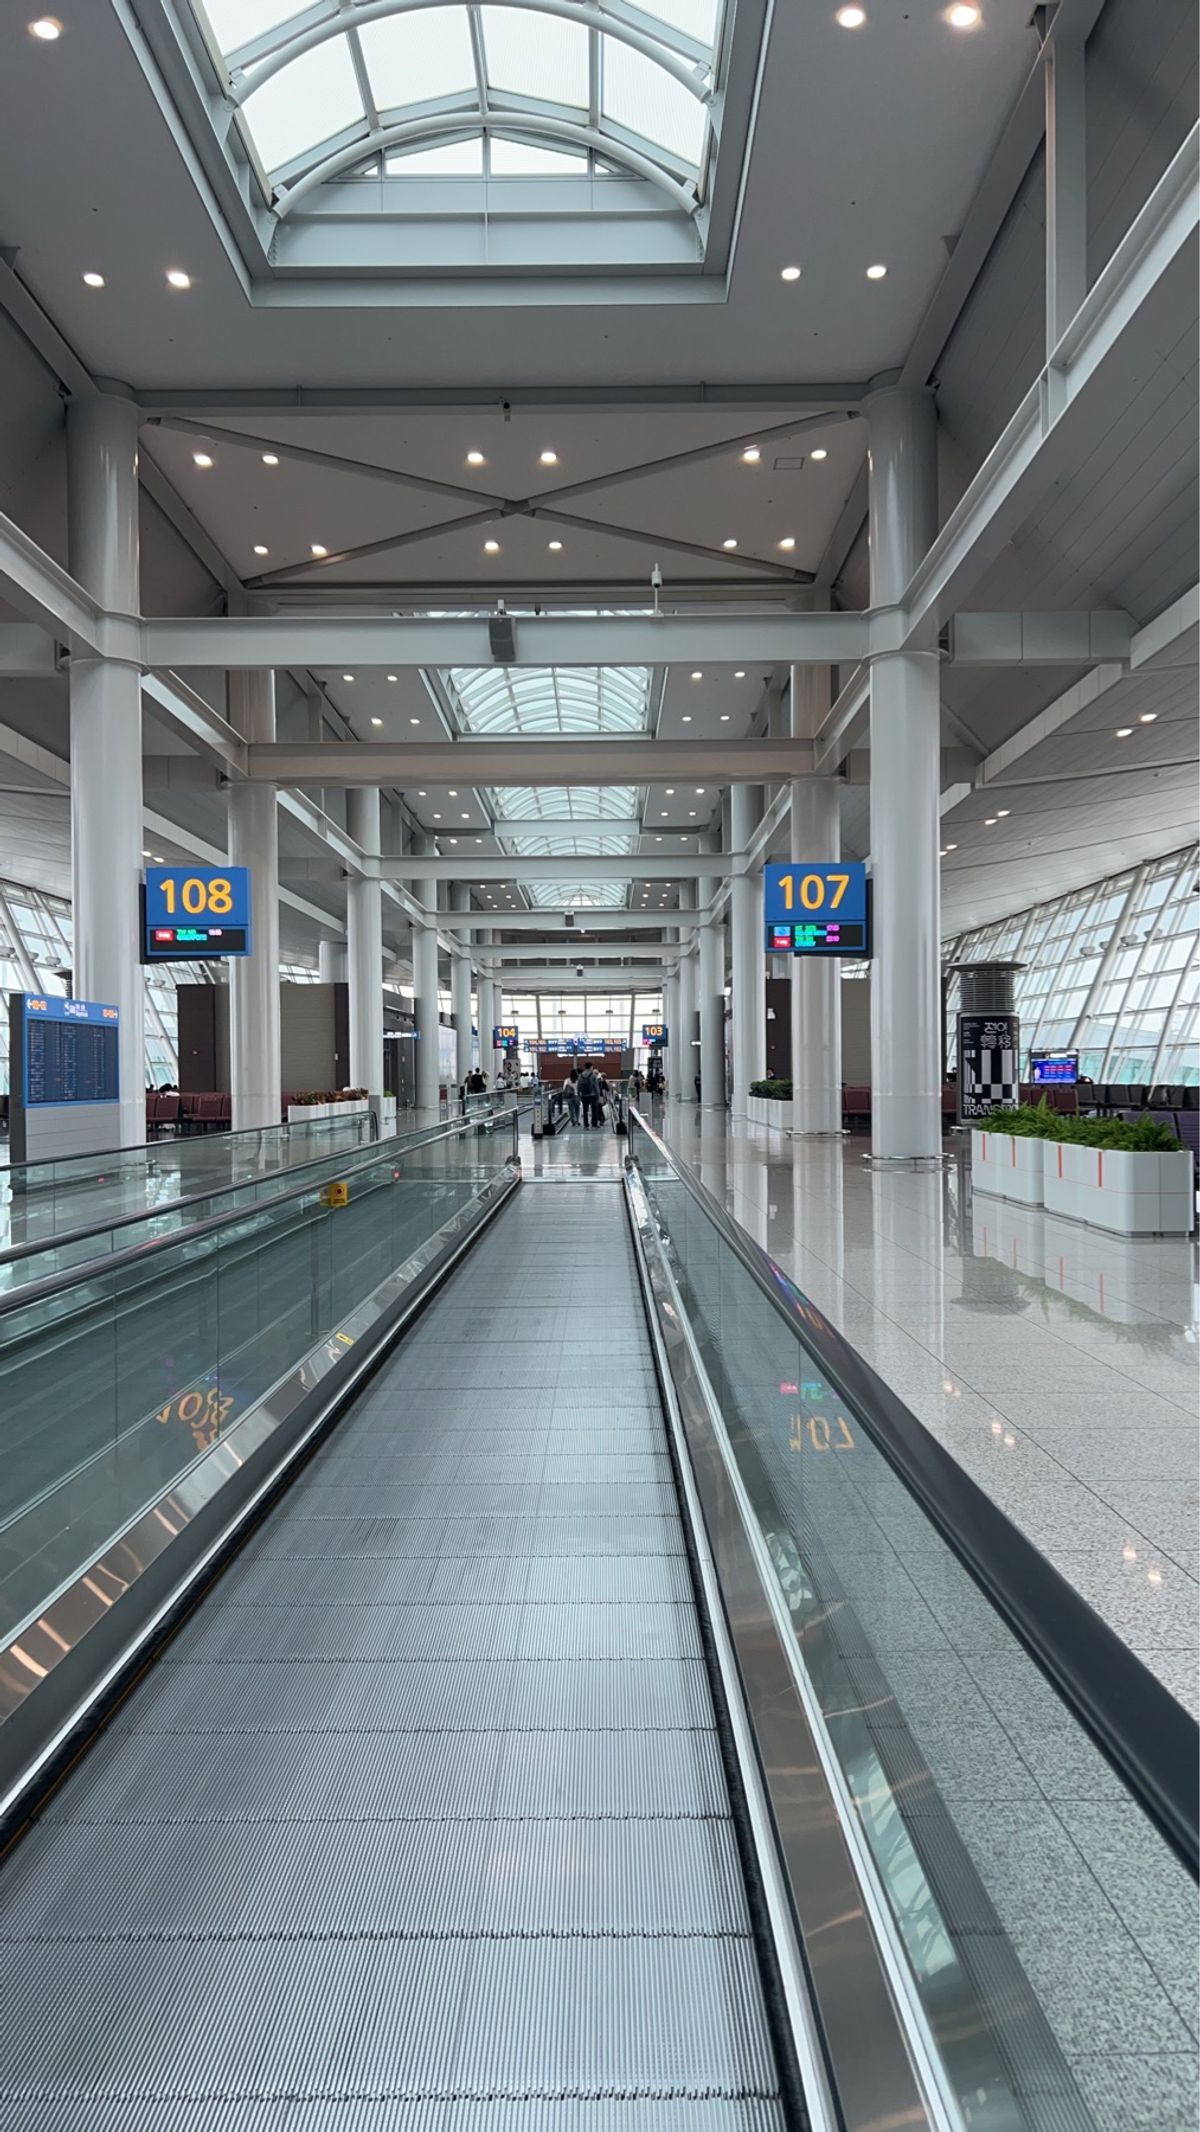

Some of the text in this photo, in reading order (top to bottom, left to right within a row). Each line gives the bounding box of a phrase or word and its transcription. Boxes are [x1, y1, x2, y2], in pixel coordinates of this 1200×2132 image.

[159, 878, 233, 914] 108
[778, 874, 850, 910] 107
[497, 1027, 516, 1038] 104
[644, 1026, 663, 1036] 103
